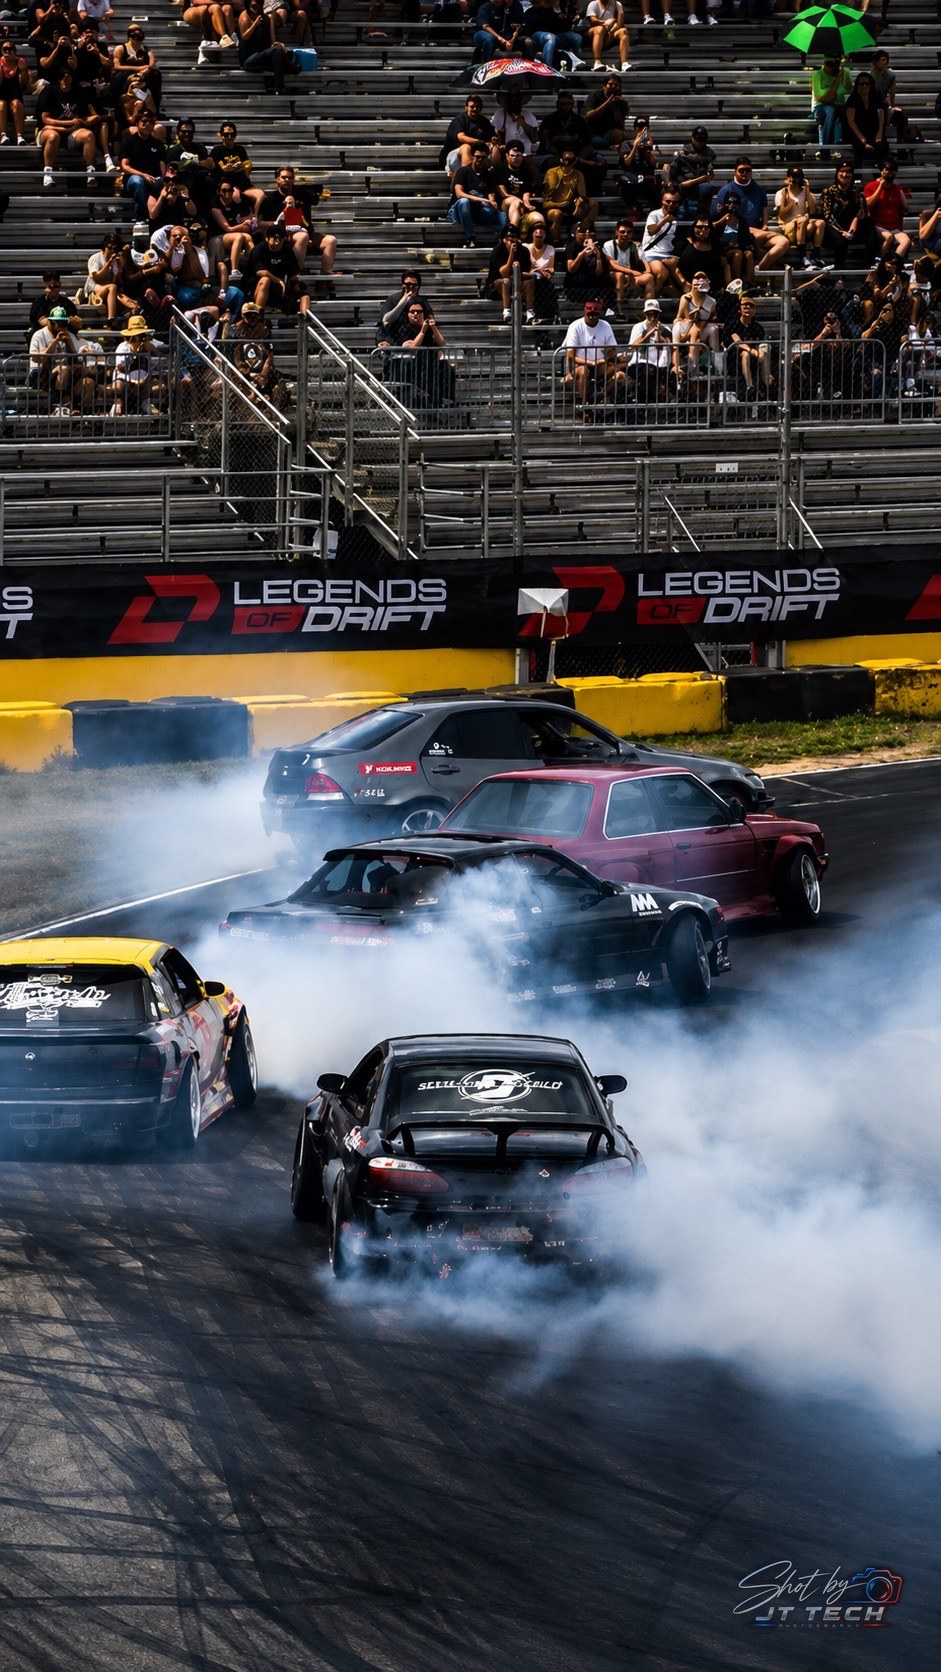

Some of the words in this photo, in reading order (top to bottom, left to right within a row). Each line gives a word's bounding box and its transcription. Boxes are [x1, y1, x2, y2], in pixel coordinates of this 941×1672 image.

[234, 578, 447, 605] LEGENDS
[638, 567, 841, 597] LEGENDS
[246, 611, 292, 628] OF
[301, 604, 447, 632] DRIFT
[650, 603, 695, 620] OF
[703, 593, 840, 624] DRIFT
